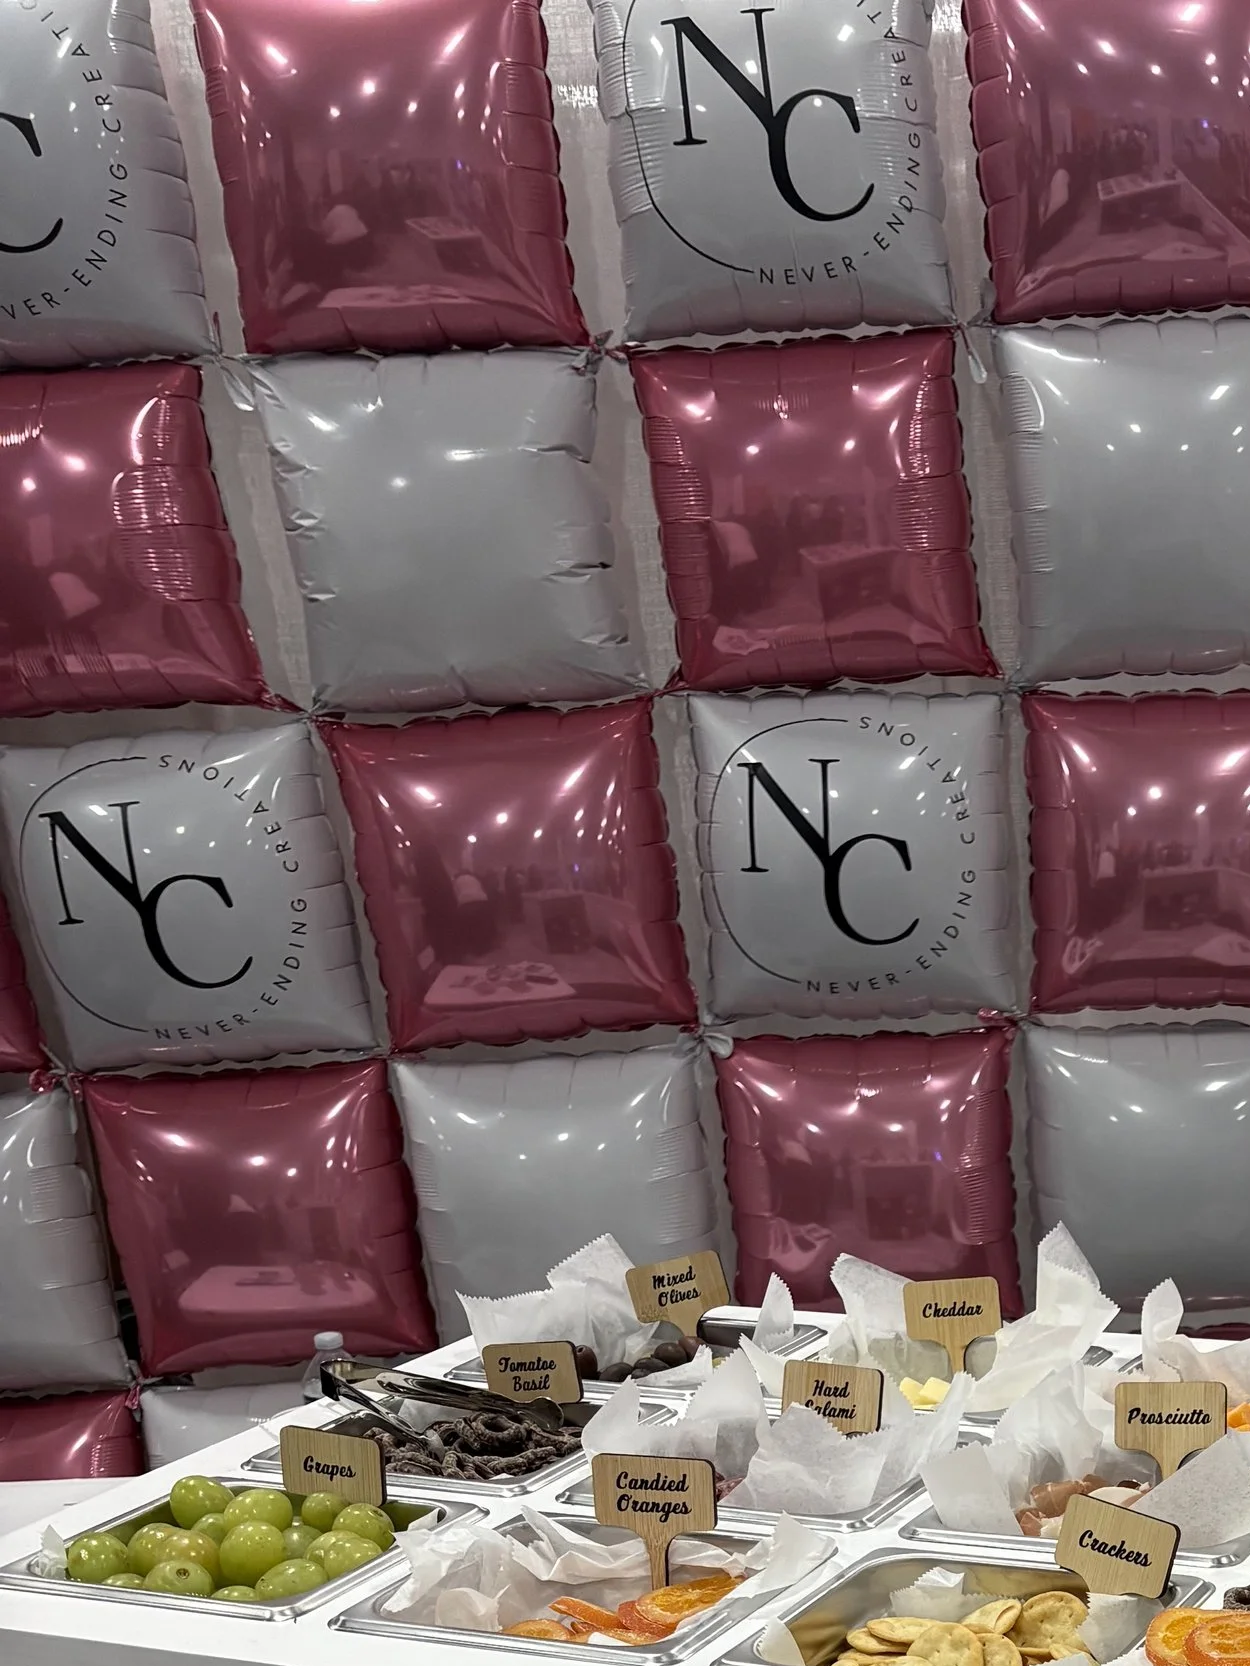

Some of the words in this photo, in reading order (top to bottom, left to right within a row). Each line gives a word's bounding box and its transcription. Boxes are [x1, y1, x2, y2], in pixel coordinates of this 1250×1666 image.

[759, 132, 921, 285] NEVER-ENDING
[857, 0, 917, 112] CREATI
[0, 163, 128, 320] VER-ENDING
[859, 716, 976, 845] CREATIONS
[159, 754, 300, 873] CREATIONS
[807, 869, 976, 993] NEVER-ENDING
[155, 898, 308, 1040] NEVER-ENDING
[652, 1265, 696, 1290] Mixed
[658, 1288, 701, 1307] Olives
[922, 1301, 983, 1318] Cheddar
[498, 1356, 557, 1373] Tomatoe
[512, 1374, 550, 1392] Basil
[813, 1379, 850, 1398] Hard
[1127, 1407, 1212, 1425] Prosciutto
[303, 1455, 357, 1482] Grapes
[616, 1471, 690, 1492] Candied
[617, 1493, 692, 1523] Oranges
[1079, 1530, 1152, 1567] Crackers
